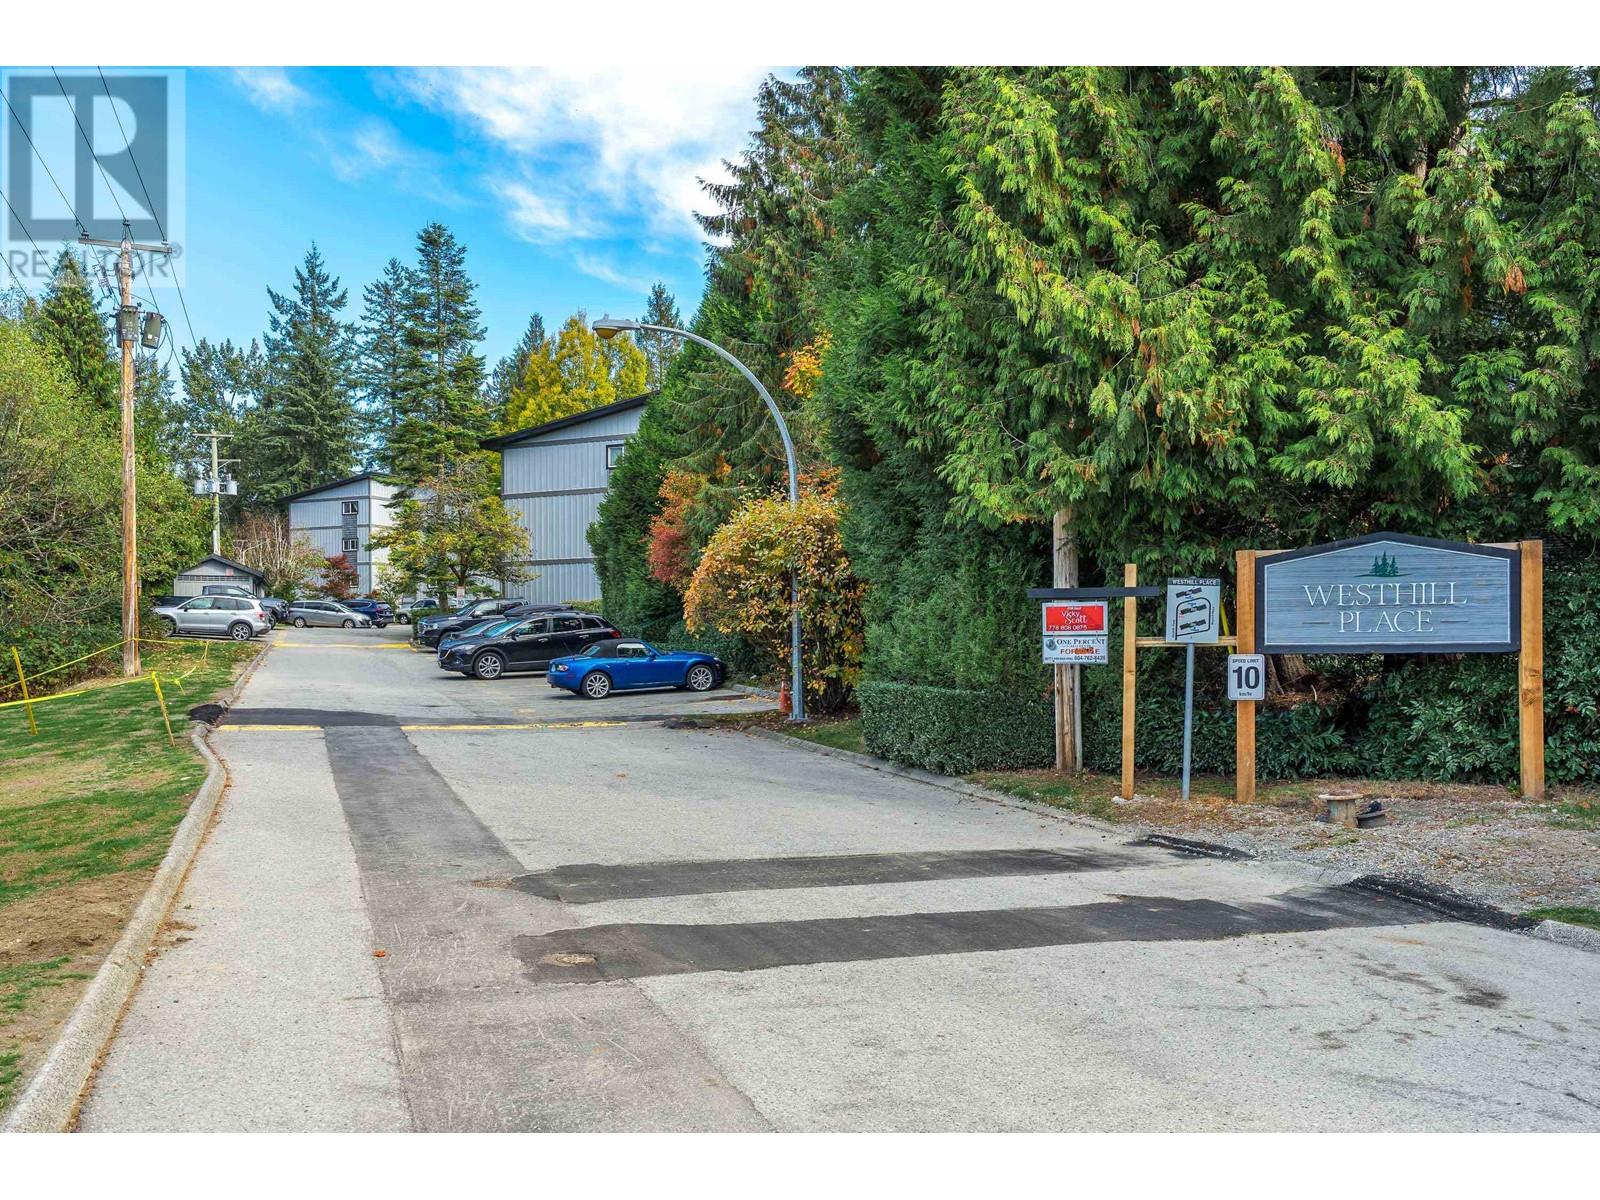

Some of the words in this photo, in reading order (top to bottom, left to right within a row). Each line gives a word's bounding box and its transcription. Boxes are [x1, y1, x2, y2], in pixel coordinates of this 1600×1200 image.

[1303, 582, 1467, 606] WESTHILL
[1065, 614, 1088, 624] Scott
[1338, 609, 1434, 633] PLACE
[1232, 666, 1260, 689] 10
